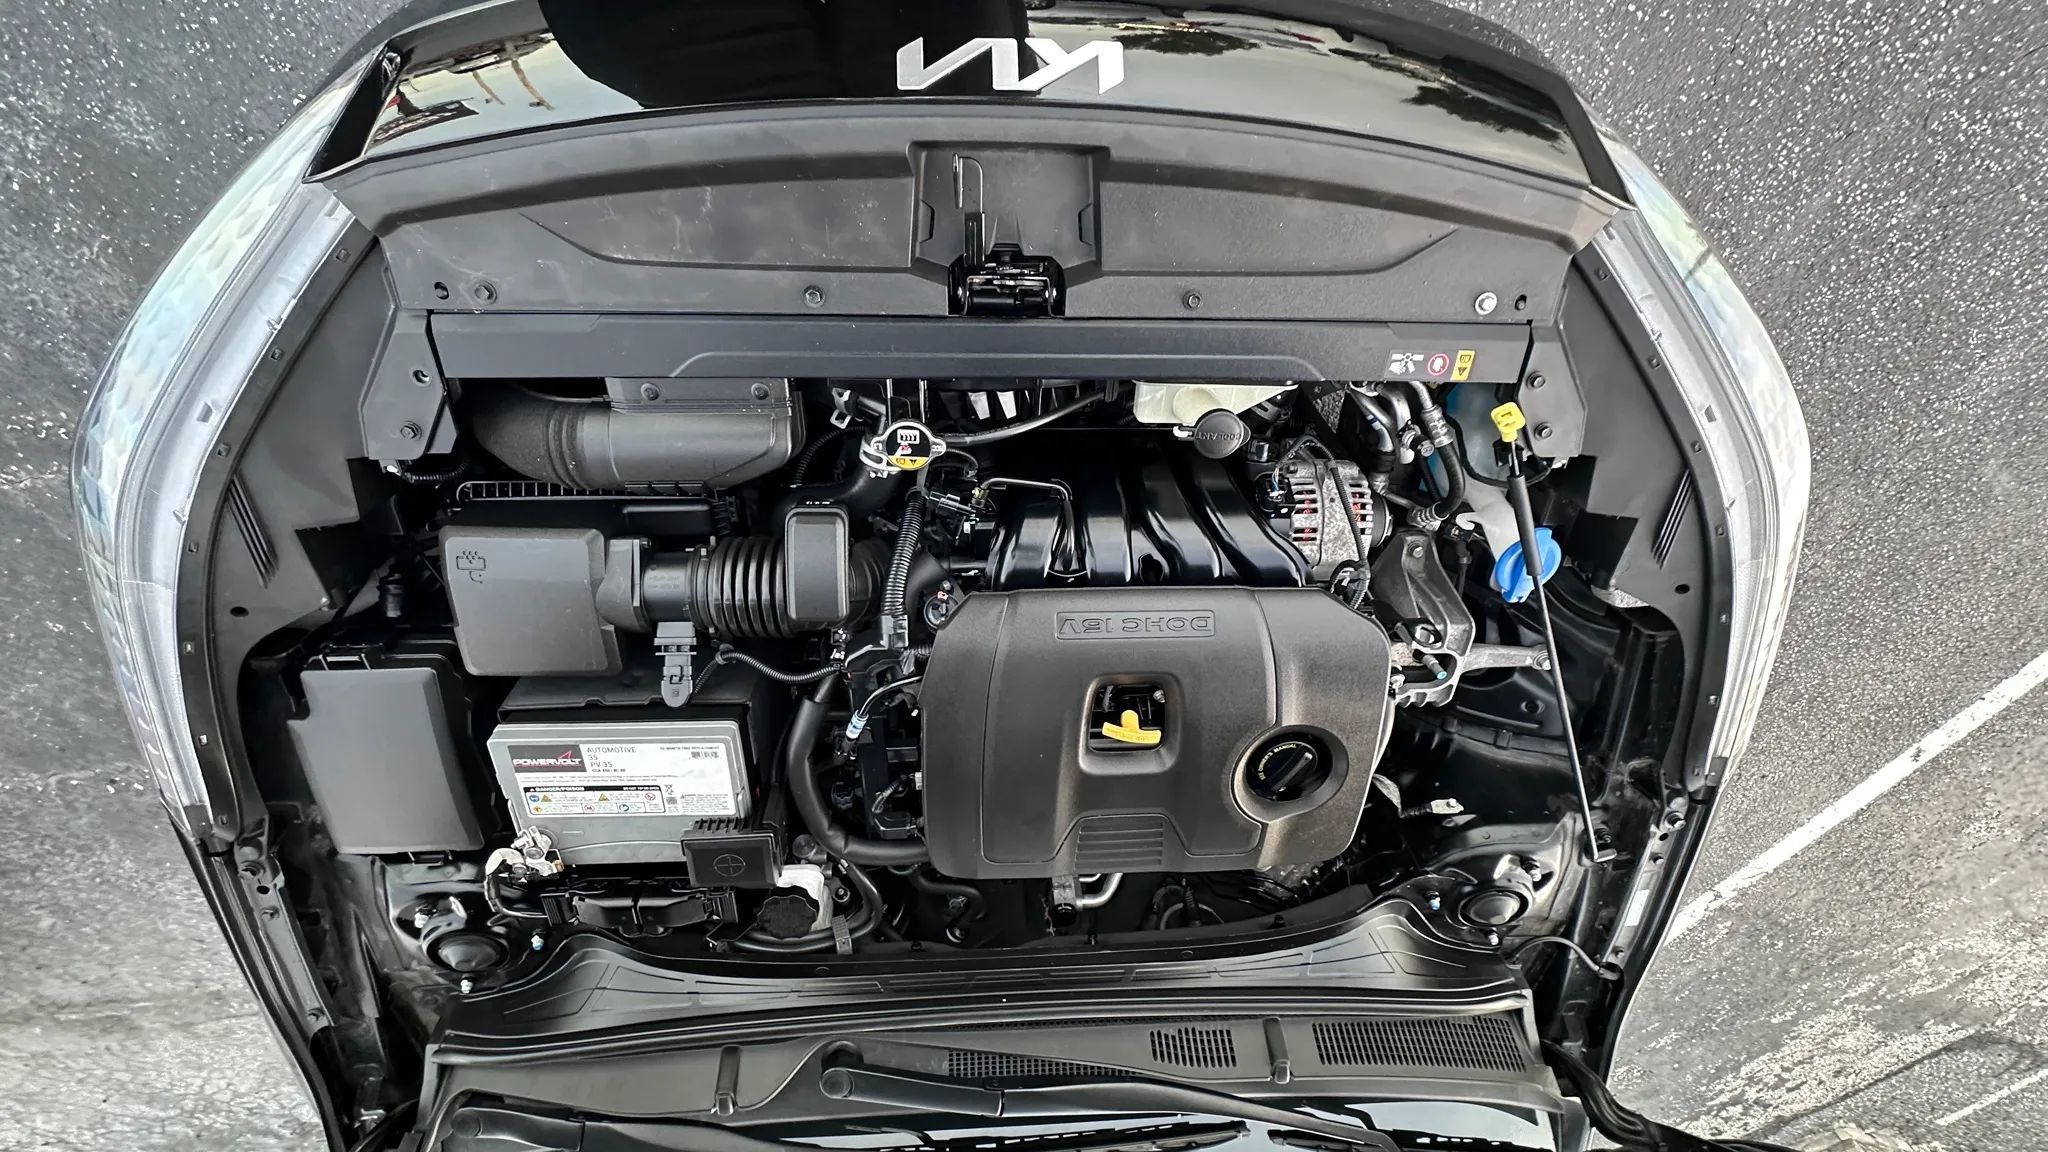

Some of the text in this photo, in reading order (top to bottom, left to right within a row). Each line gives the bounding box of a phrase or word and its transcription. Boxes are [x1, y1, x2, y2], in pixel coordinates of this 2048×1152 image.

[897, 36, 1125, 95] KIA
[1193, 430, 1242, 442] COOLANT
[1059, 615, 1212, 635] DOHC 16V
[512, 757, 582, 767] POWERVOLT
